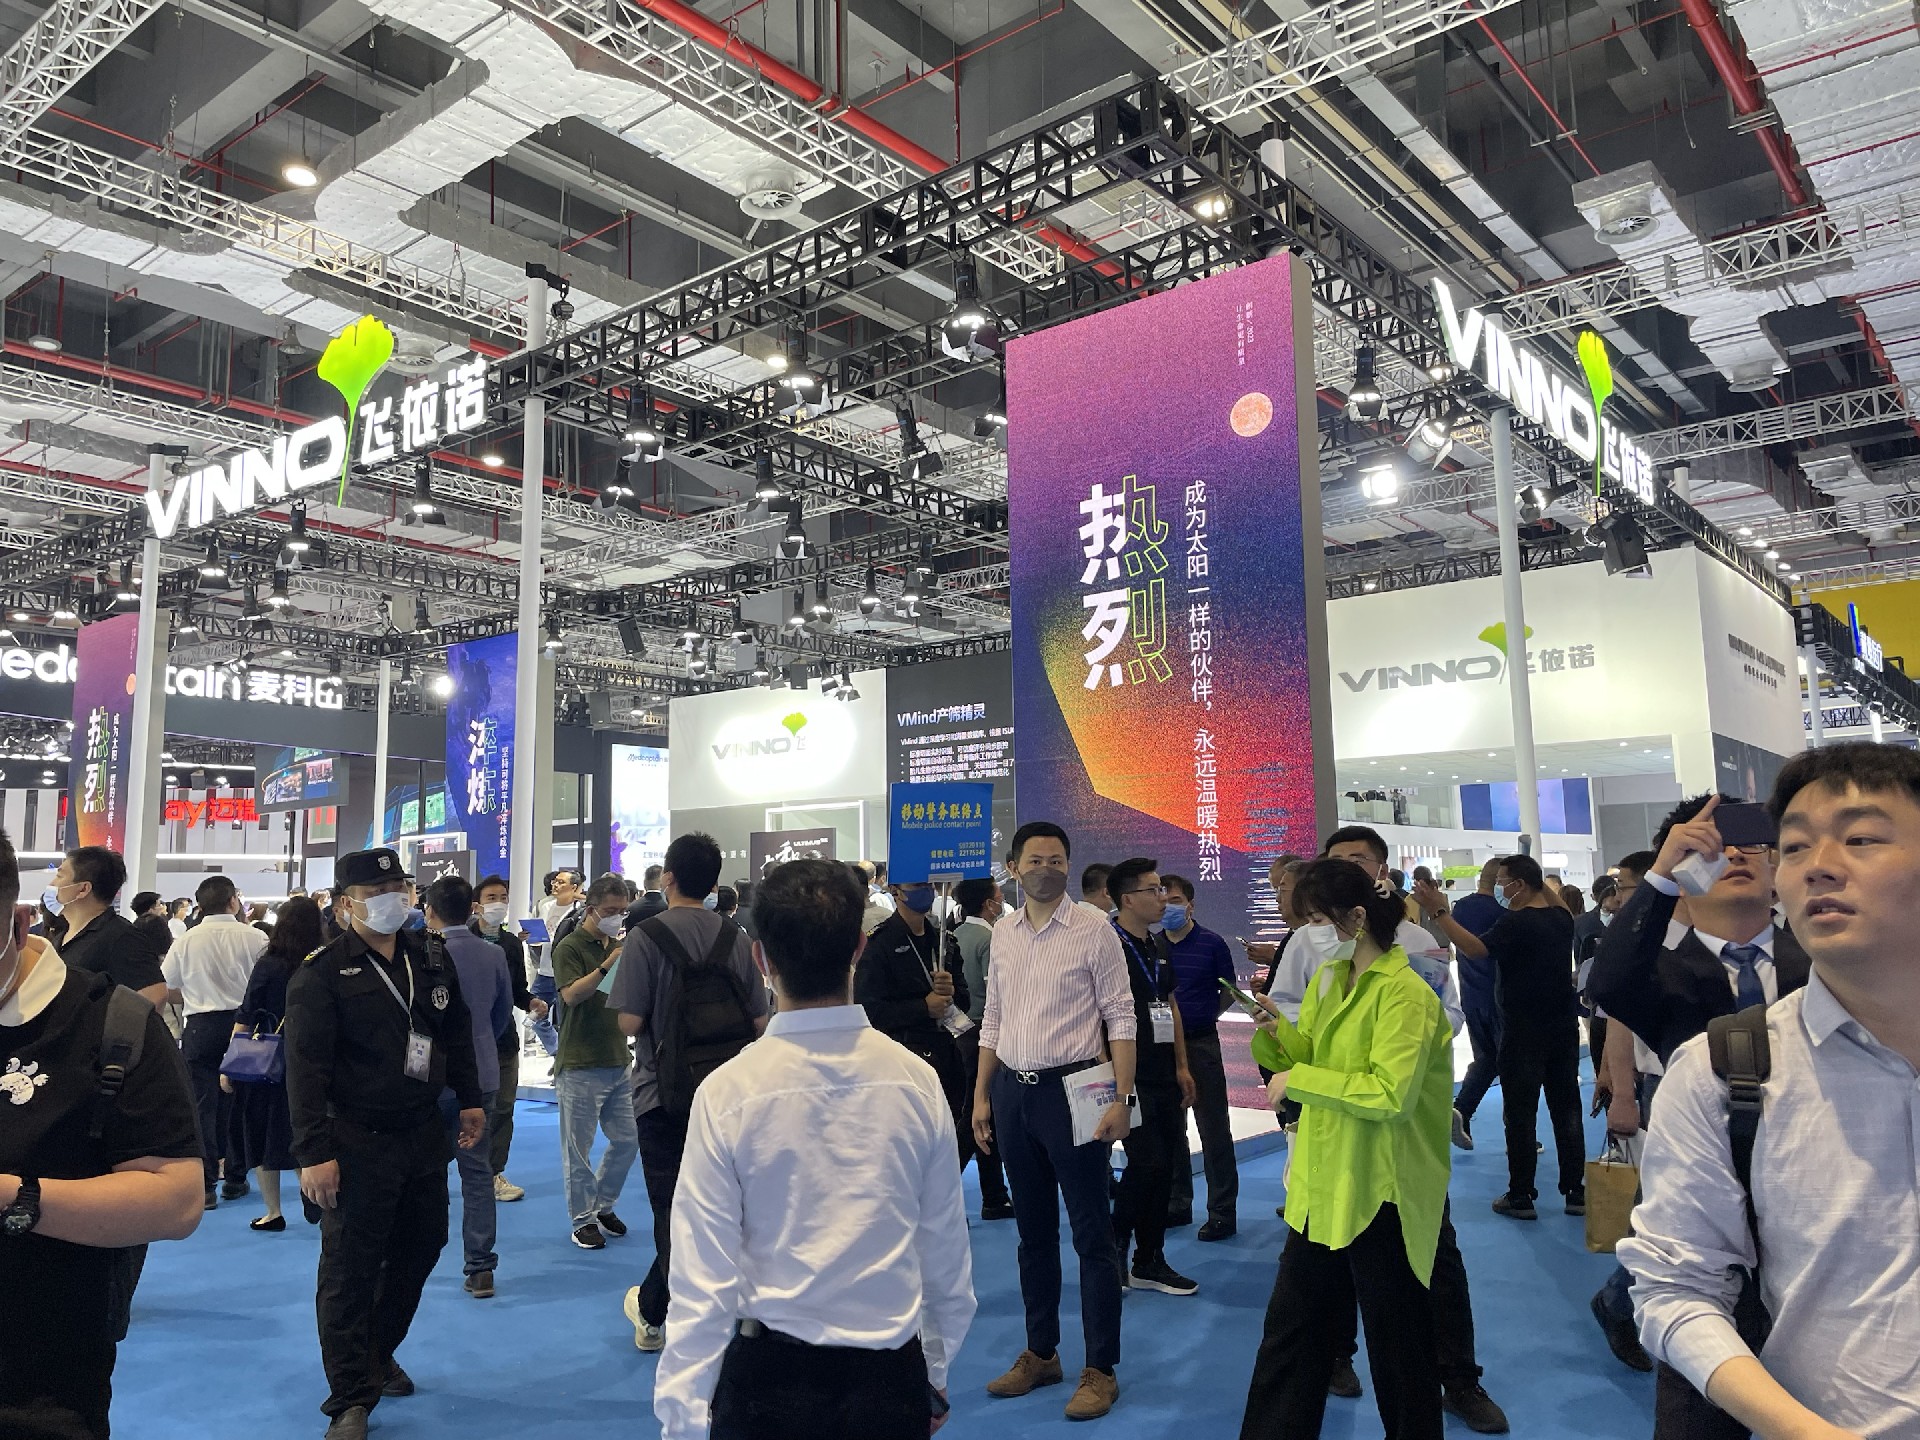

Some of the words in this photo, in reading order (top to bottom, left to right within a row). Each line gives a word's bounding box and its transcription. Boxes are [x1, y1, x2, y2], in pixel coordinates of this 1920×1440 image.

[359, 354, 490, 466] 飞依诺
[1430, 276, 1598, 462] VINNO
[145, 416, 348, 539] VINNO
[1079, 475, 1173, 691] 热烈
[1338, 655, 1502, 693] VINNO
[83, 706, 110, 814] 热烈
[711, 737, 791, 760] VINNO
[901, 802, 983, 821] 移动警务联络点
[902, 821, 923, 829] Mobile
[924, 821, 942, 830] police
[966, 820, 981, 829] point
